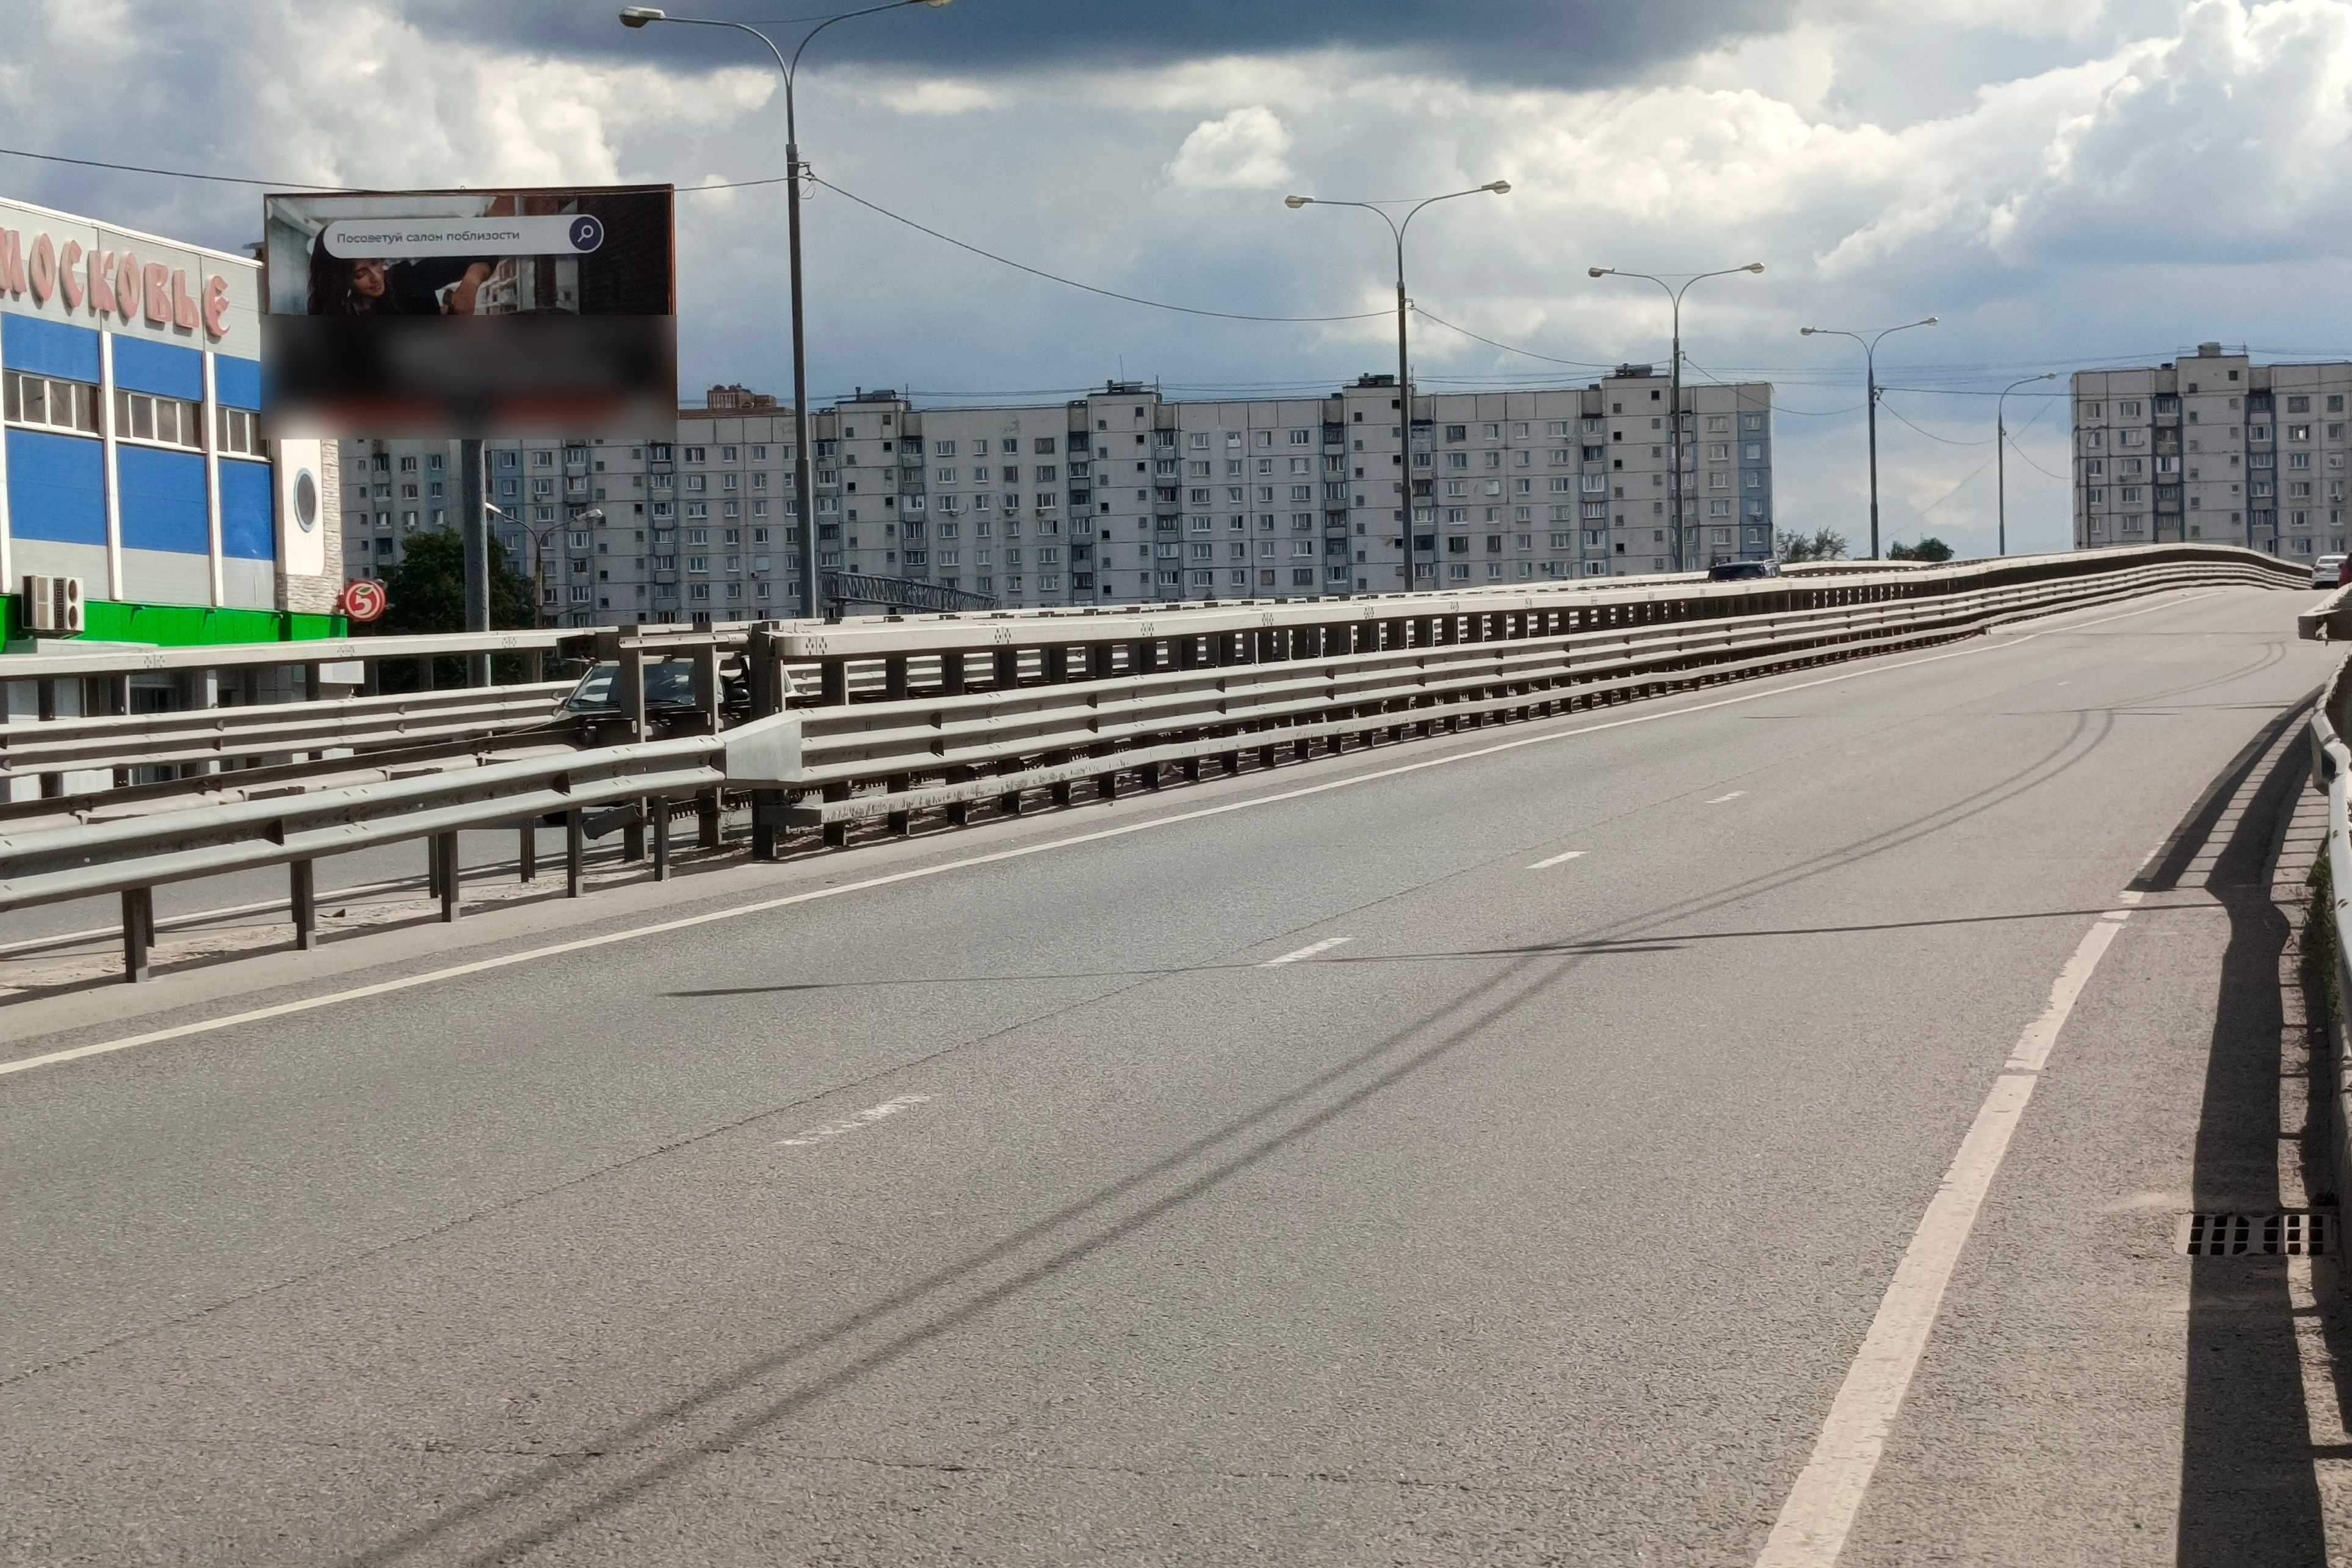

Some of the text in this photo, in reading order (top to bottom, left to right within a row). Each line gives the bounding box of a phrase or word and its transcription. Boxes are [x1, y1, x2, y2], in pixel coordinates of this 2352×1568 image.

[337, 231, 519, 245] Посоветуй салон поблизости
